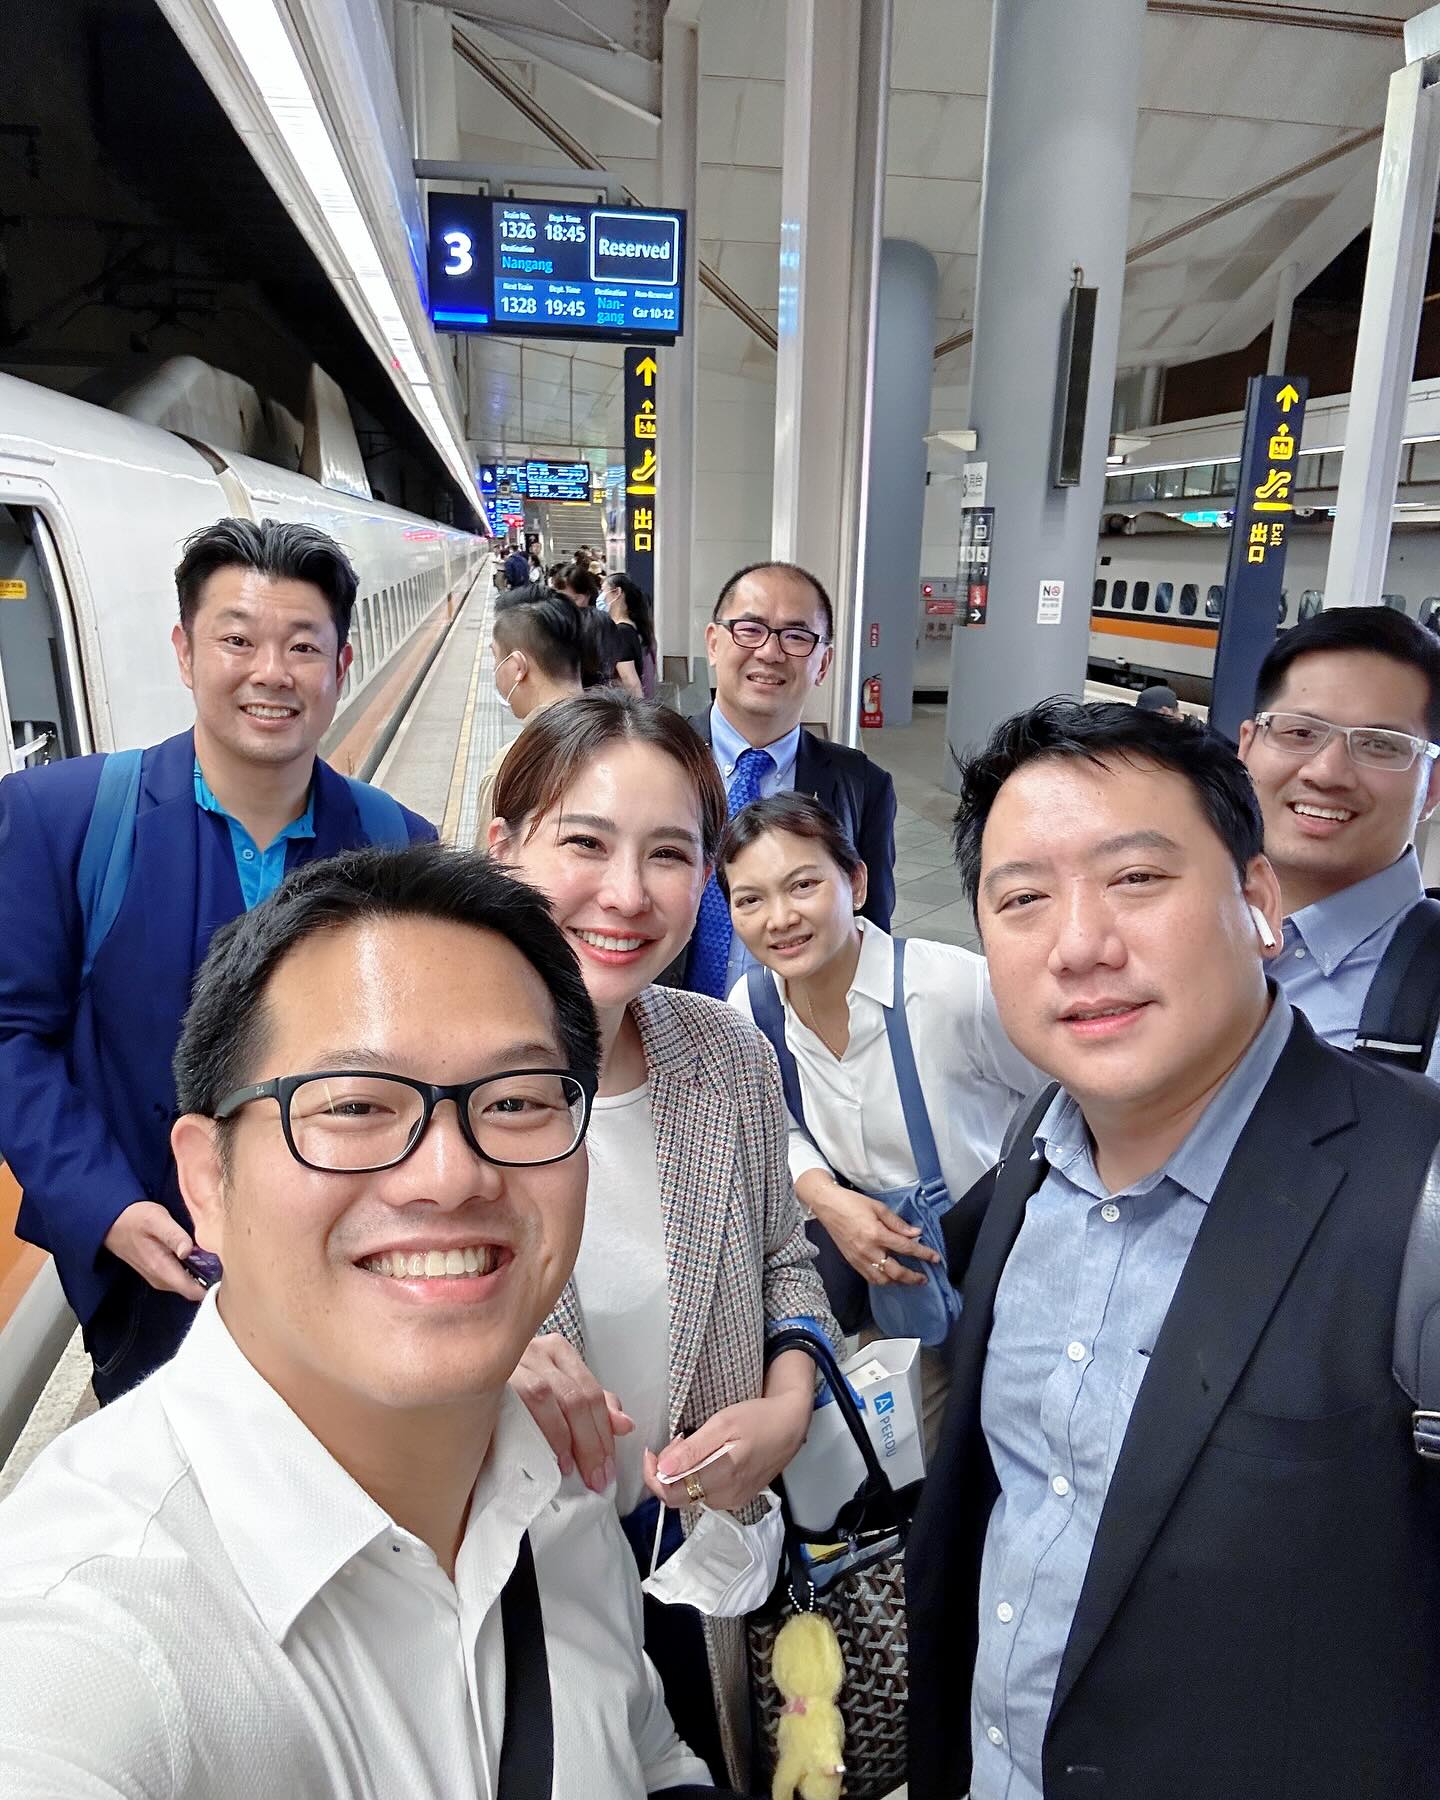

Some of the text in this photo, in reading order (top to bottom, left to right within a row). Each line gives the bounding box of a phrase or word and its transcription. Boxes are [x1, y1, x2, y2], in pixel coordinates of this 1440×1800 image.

[500, 221, 537, 239] 1326
[544, 224, 587, 242] 18:45
[443, 231, 474, 276] 3
[599, 238, 670, 260] Reserved
[502, 256, 554, 274] Nangang
[501, 297, 537, 314] 1328
[545, 299, 586, 317] 19:45
[597, 297, 625, 309] Nan-
[597, 312, 625, 325] gang
[632, 307, 675, 320] Car 10-12
[634, 507, 652, 551] 出口
[1270, 523, 1284, 547] Exit
[1248, 522, 1268, 563] 出口
[880, 1416, 896, 1457] PERDU
